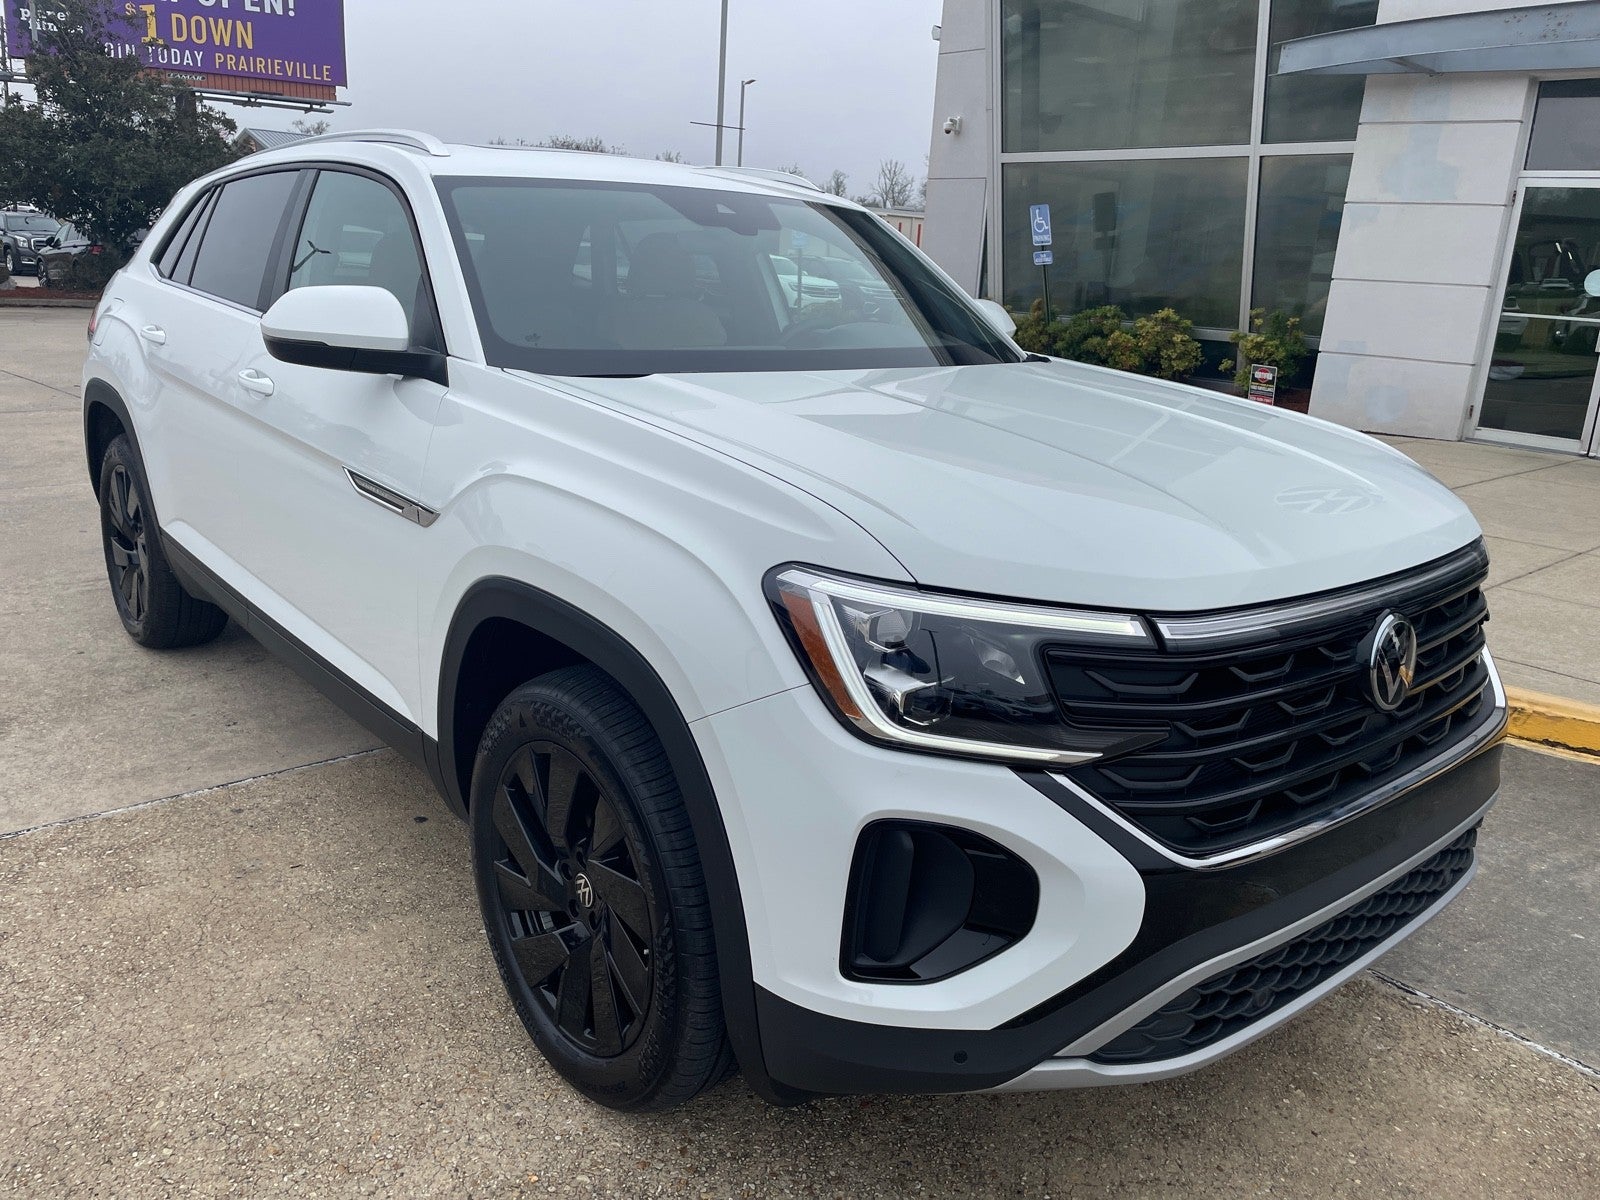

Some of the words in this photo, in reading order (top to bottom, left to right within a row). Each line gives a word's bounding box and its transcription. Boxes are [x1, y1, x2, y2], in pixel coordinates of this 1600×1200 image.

[171, 13, 253, 50] DOWN
[97, 41, 136, 58] OIN
[145, 45, 203, 67] TODAY
[215, 52, 332, 82] PRAIRIEVILLE
